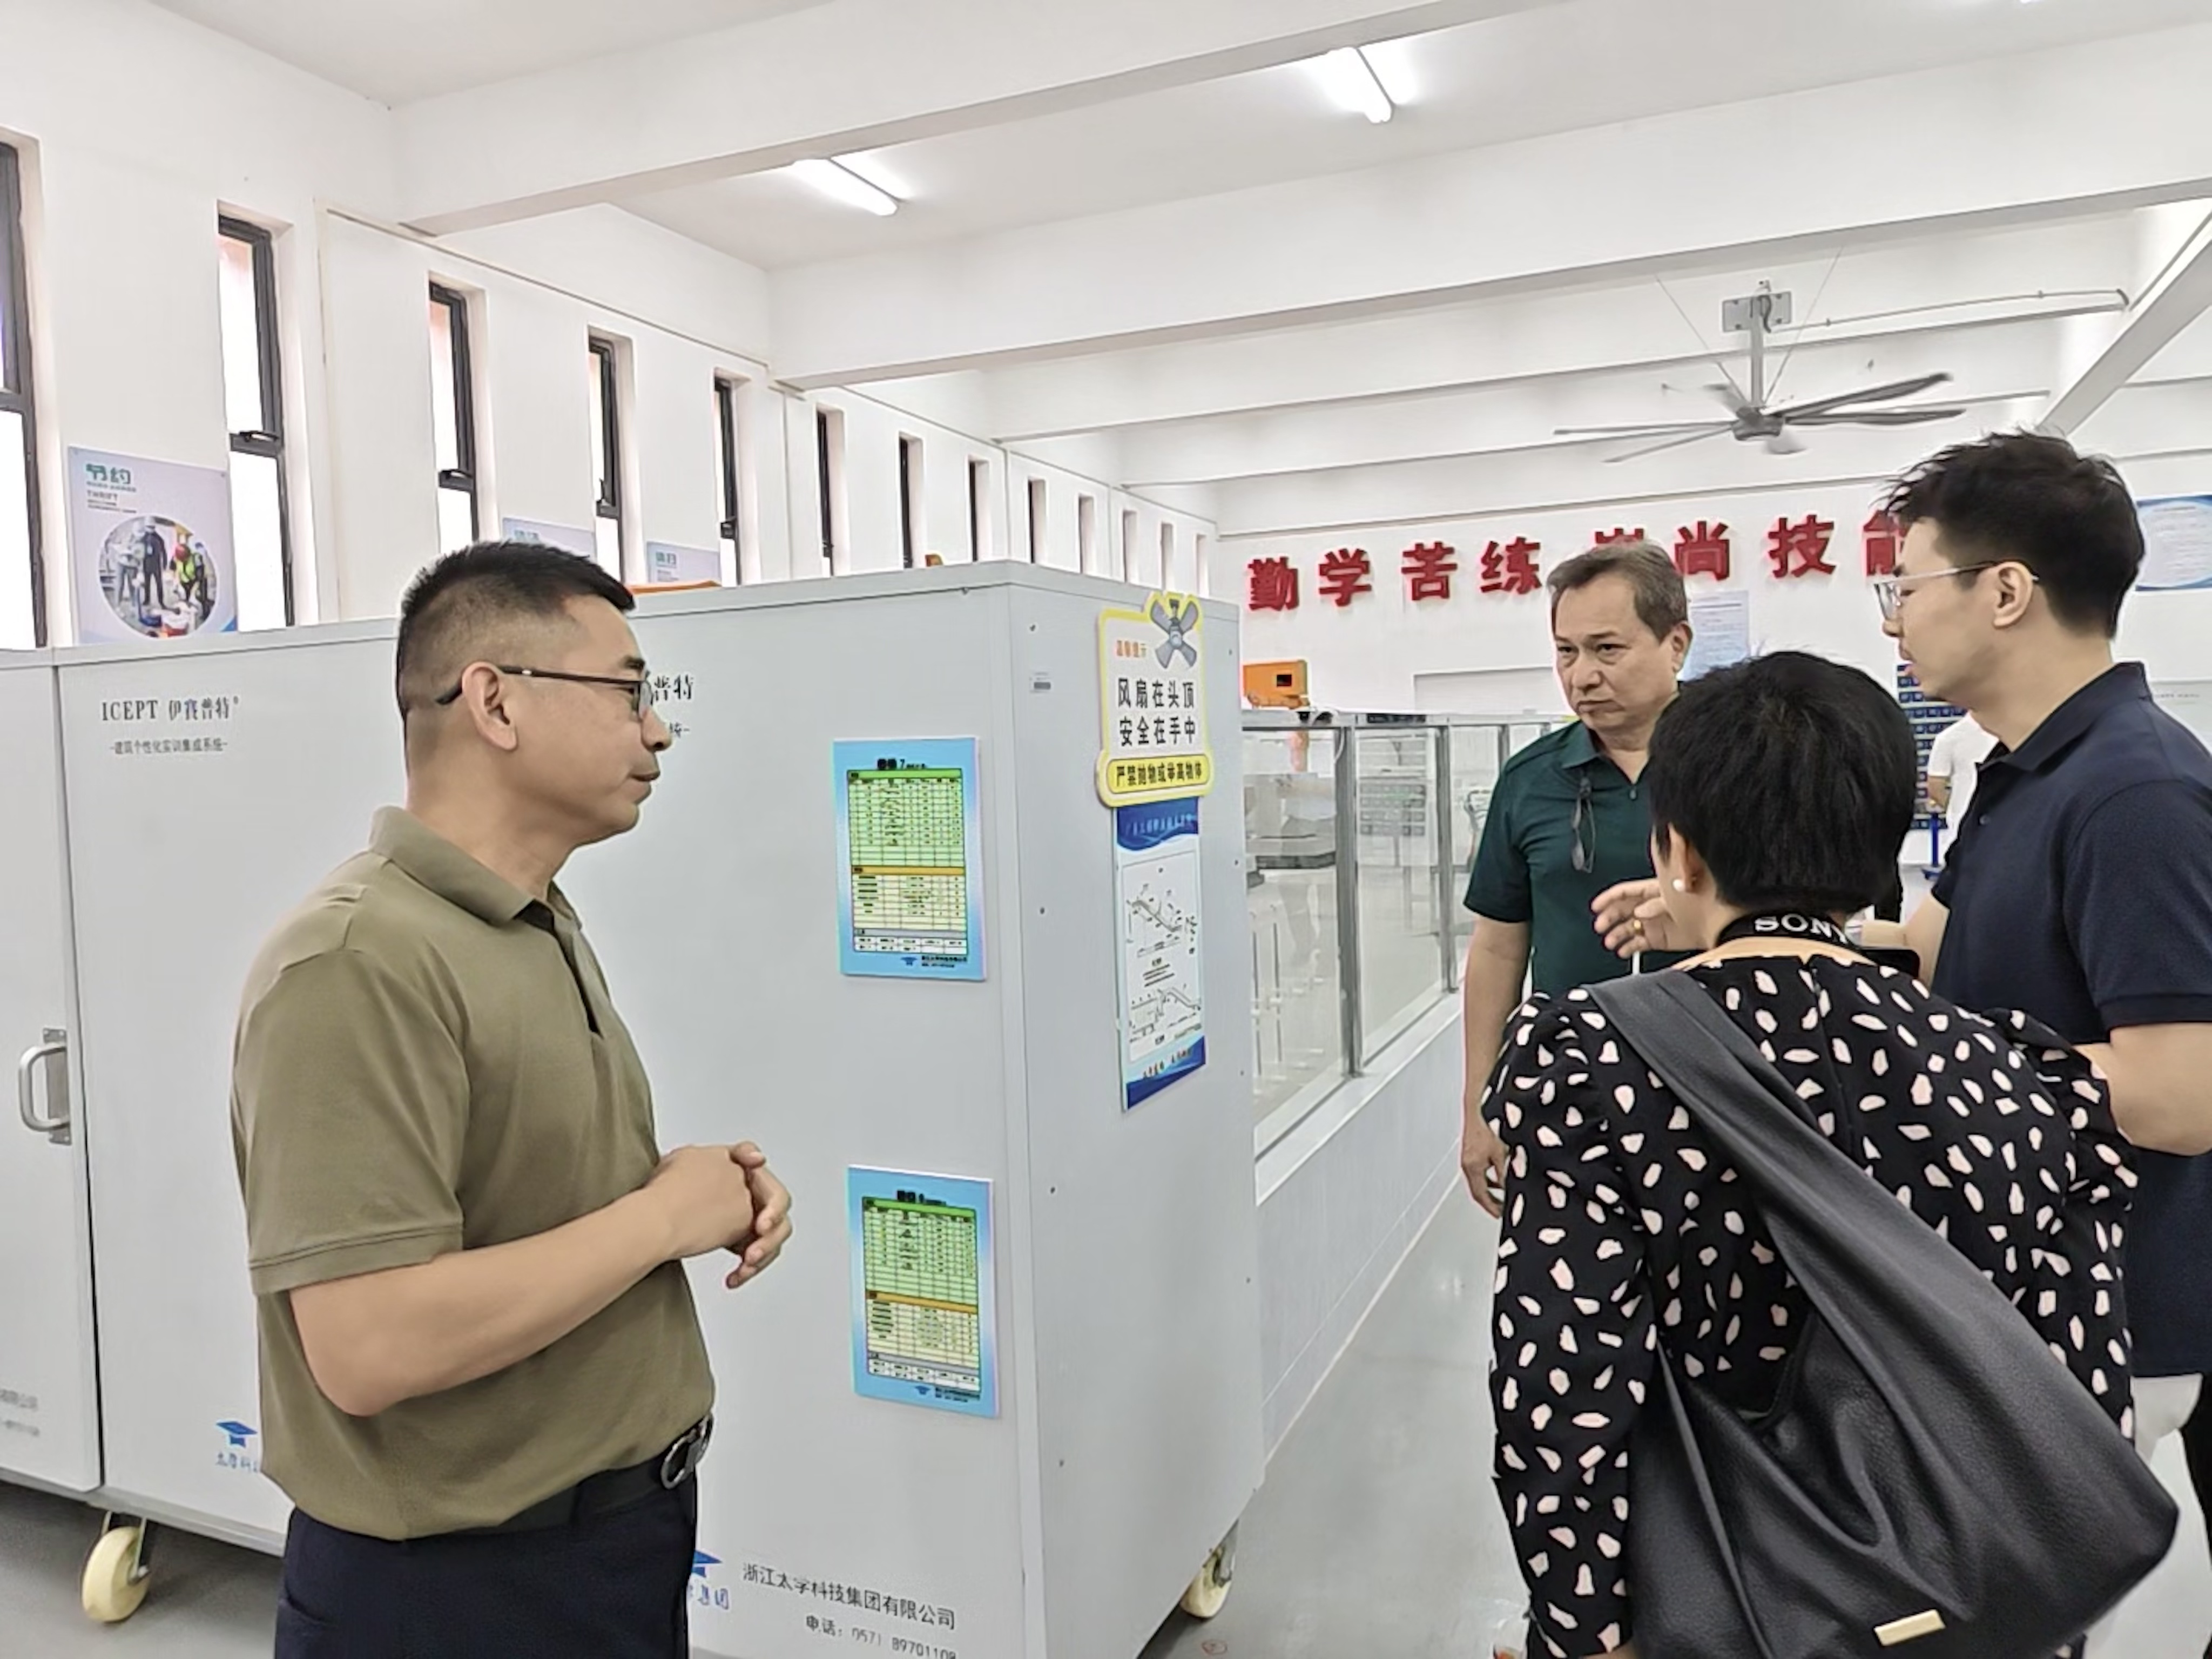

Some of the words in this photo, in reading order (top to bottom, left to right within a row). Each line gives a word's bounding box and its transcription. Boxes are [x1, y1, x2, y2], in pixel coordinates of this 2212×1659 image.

[1247, 536, 1543, 611] 勤学苦练
[1118, 677, 1195, 709] 风扇在头顶
[102, 699, 158, 721] ICEPT
[1120, 715, 1196, 747] 安全在手中
